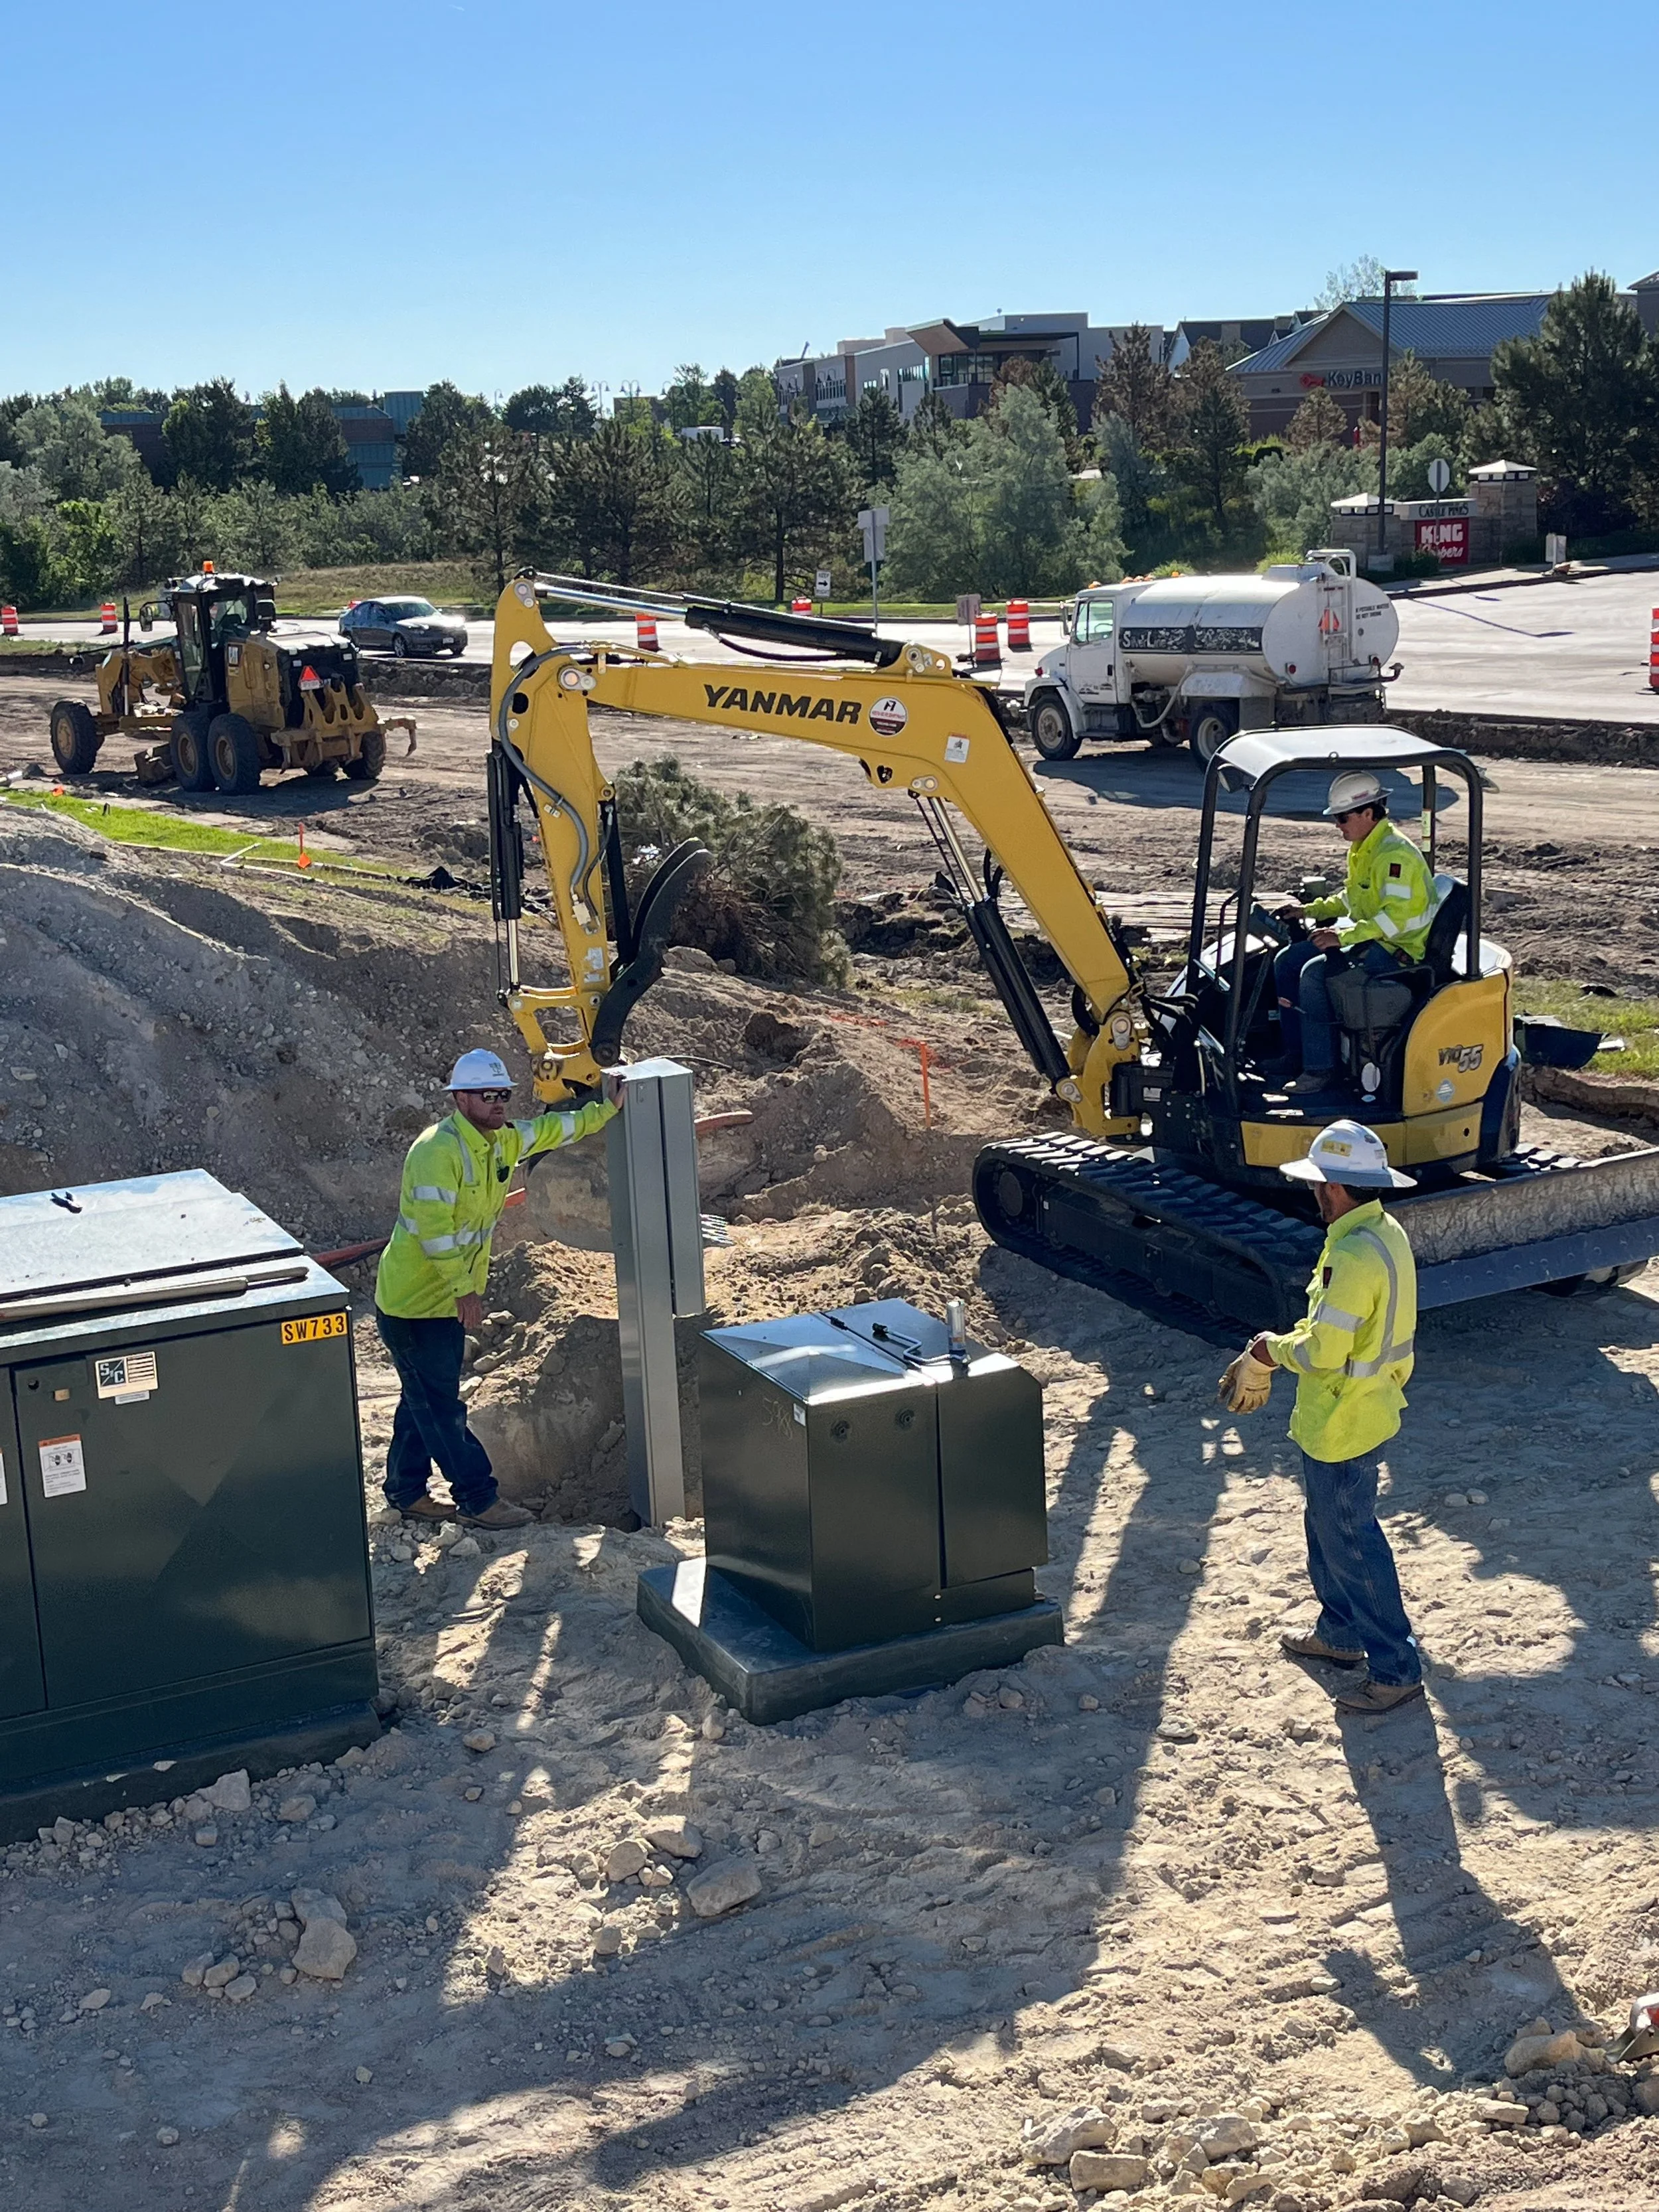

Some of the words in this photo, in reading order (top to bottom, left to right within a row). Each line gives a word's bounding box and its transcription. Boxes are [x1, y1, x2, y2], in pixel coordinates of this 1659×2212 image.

[1329, 370, 1382, 388] KeyBan
[703, 684, 862, 725] YANMAR
[283, 1315, 345, 1341] SW733
